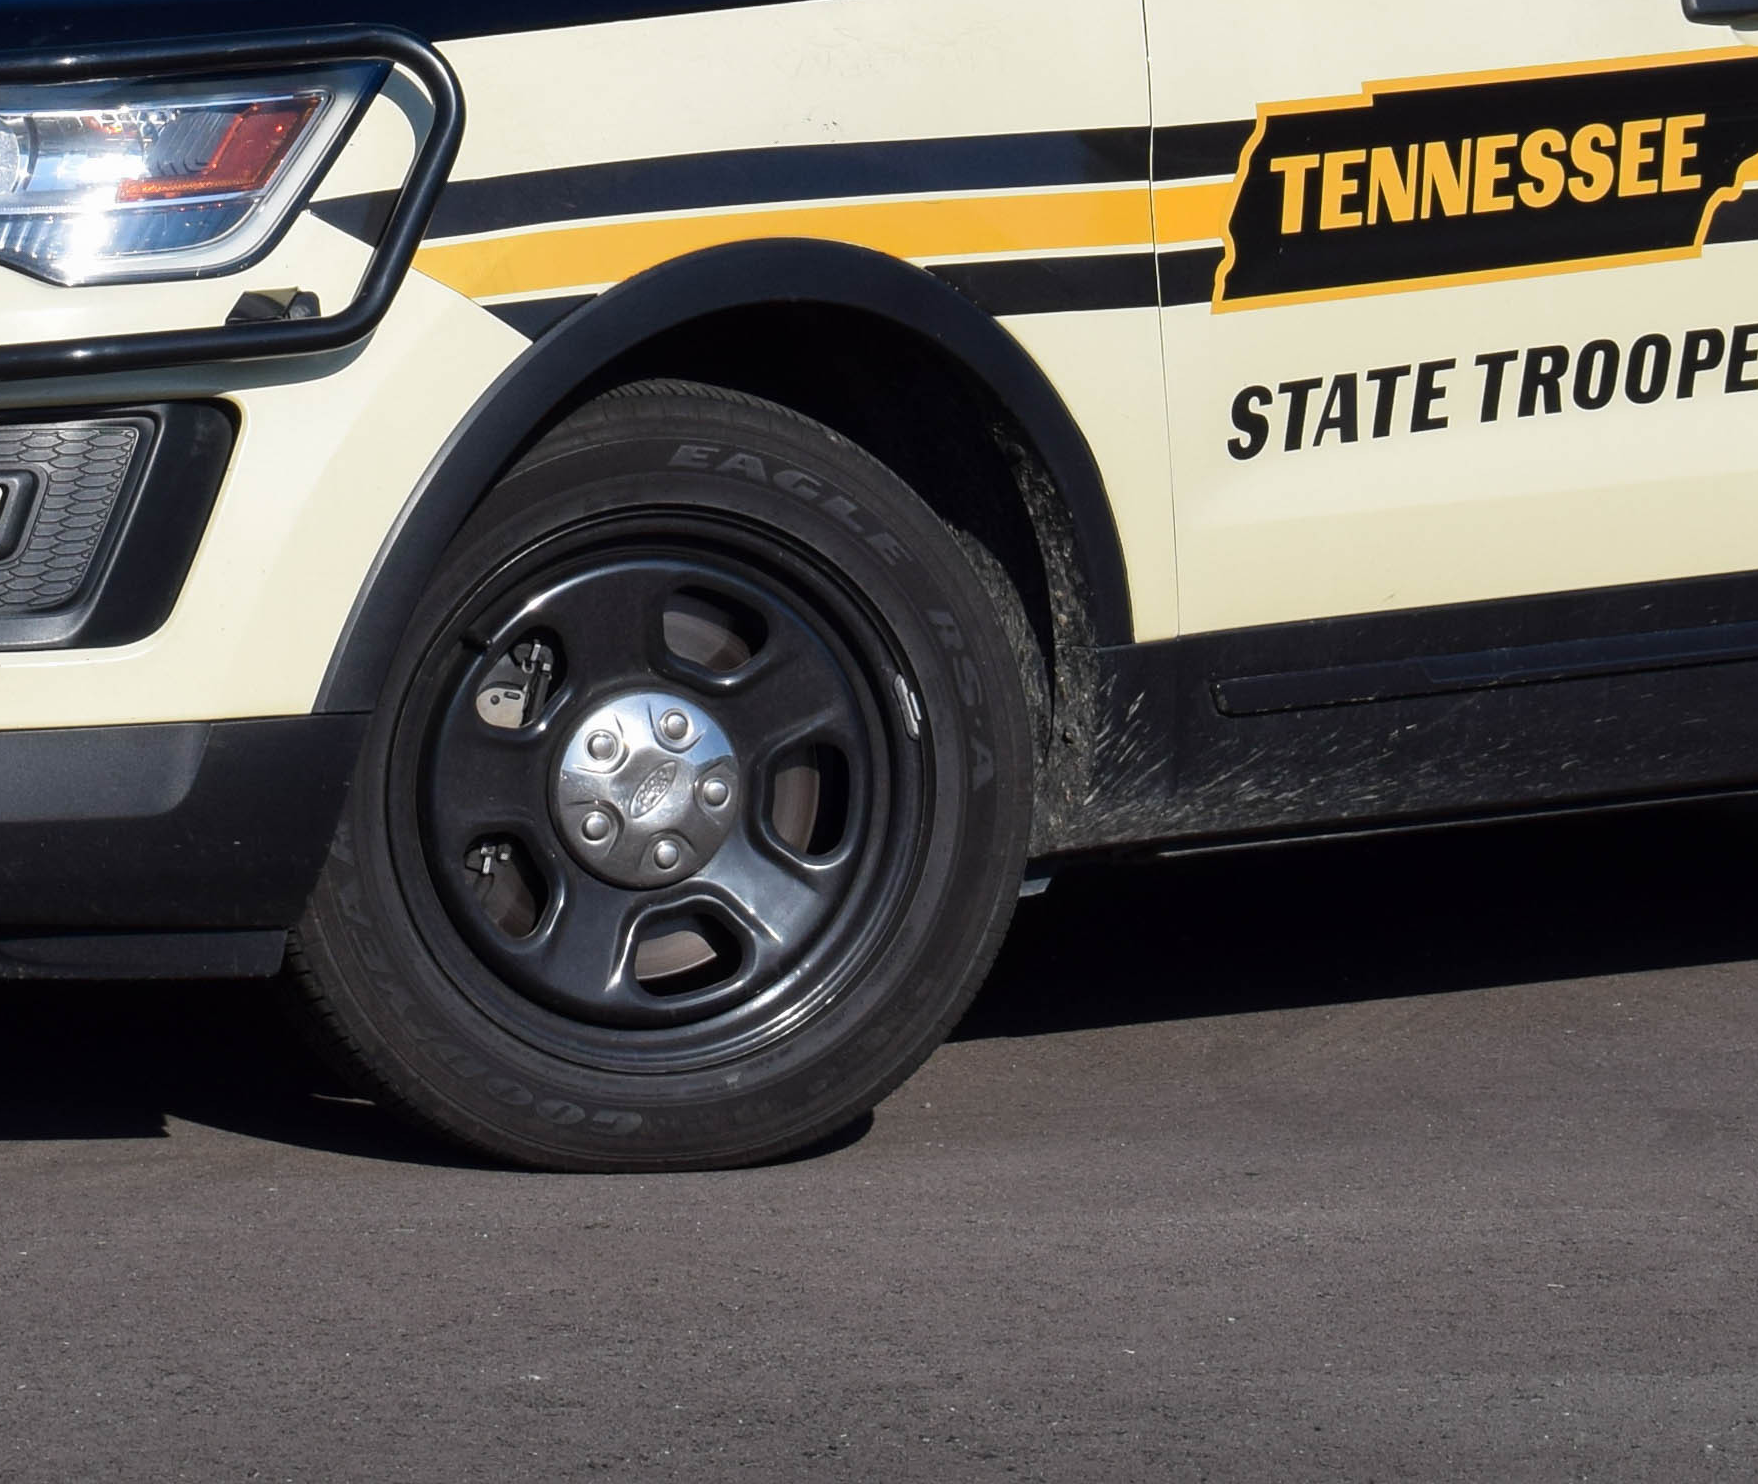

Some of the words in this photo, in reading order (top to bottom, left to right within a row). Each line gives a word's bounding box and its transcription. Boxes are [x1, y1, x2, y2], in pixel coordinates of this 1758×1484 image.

[1269, 113, 1706, 234] TENNESSEE
[1227, 358, 1457, 461] STATE
[668, 443, 914, 566] EAGLE
